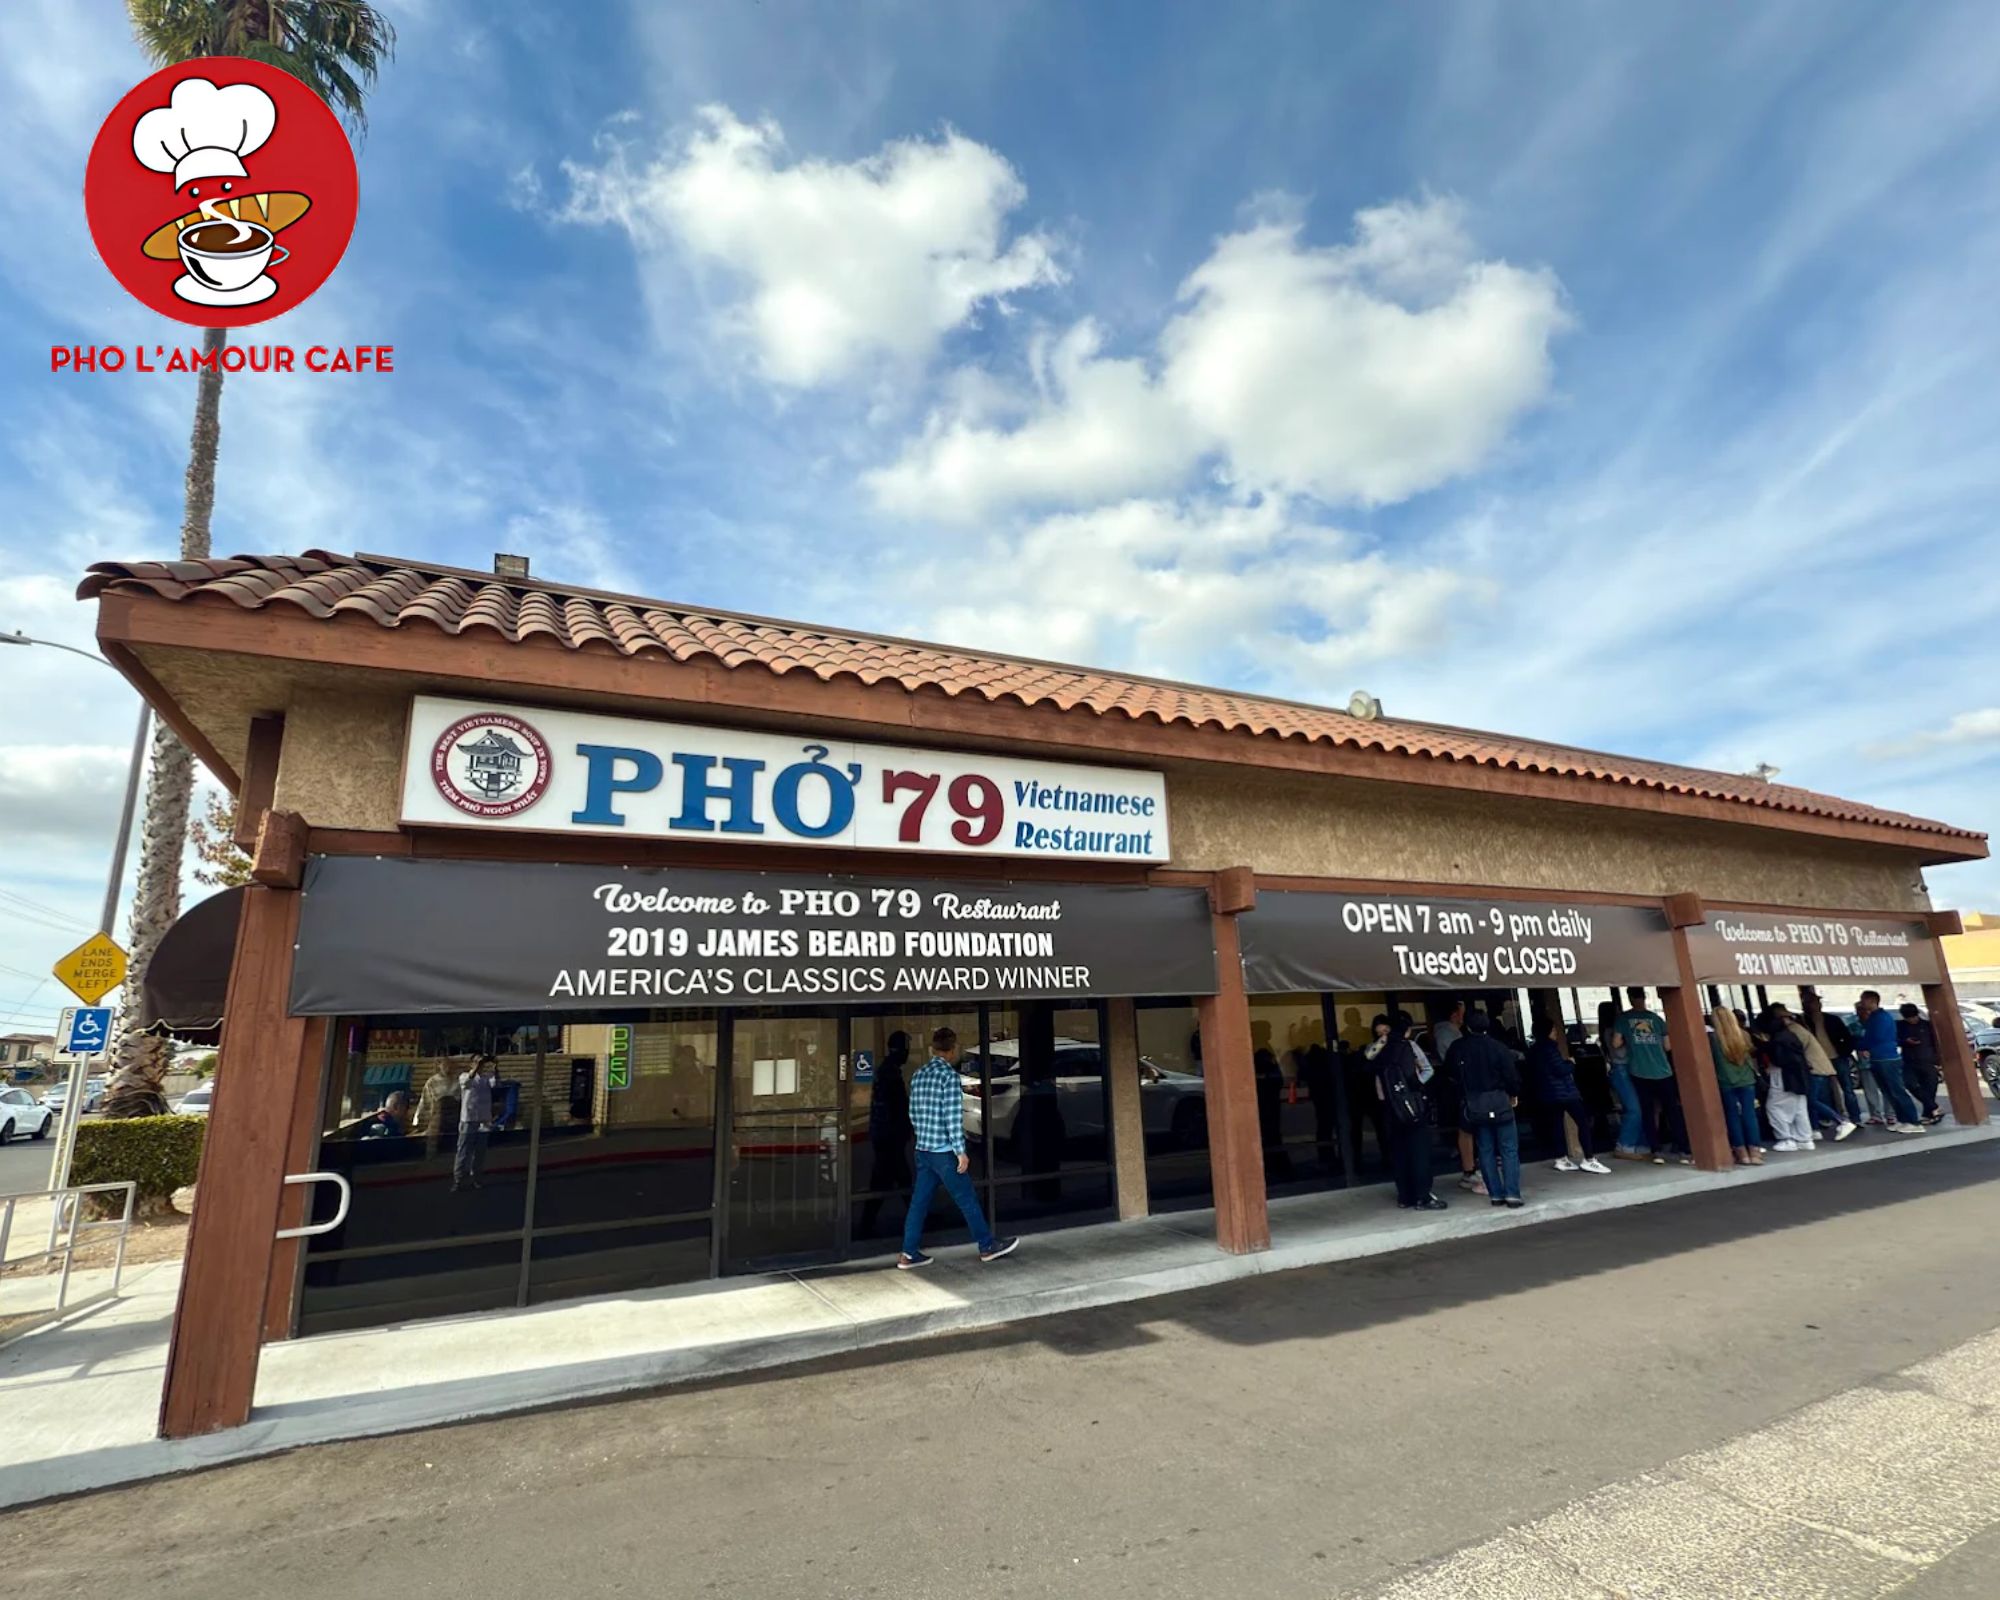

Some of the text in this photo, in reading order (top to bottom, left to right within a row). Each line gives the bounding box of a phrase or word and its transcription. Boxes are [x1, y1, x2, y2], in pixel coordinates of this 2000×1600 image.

[435, 717, 547, 784] THE BEST VIETNAMESE SOUP IN TOWN
[483, 805, 512, 814] NGON
[571, 743, 1004, 846] PHỞ 79
[1014, 780, 1155, 817] Vietnamese
[1015, 820, 1153, 855] Restaurant
[593, 883, 1062, 920] Welcome to PHO 79 Restaurant
[1342, 901, 1413, 933] OPEN
[1416, 905, 1430, 933] 7
[1438, 910, 1474, 934] am
[1489, 907, 1504, 936] 9
[1509, 914, 1544, 942] pm
[1547, 908, 1592, 944] daily
[1715, 919, 1910, 947] Welcome to PHO 79 Restaurant
[82, 947, 113, 957] LANE
[607, 927, 1053, 958] 2019 JAMES BEARD FOUNDATION
[73, 968, 117, 978] MERGE
[80, 957, 113, 968] ENDS
[1392, 945, 1577, 982] Tuesday CLOSED
[1735, 953, 1910, 977] 2021 MICHELIN BIB GOURMAND
[77, 979, 111, 989] LEFT
[549, 965, 1091, 997] AMERICA'S CLASSICS AWARD WINNER
[610, 1027, 629, 1087] OPEN
